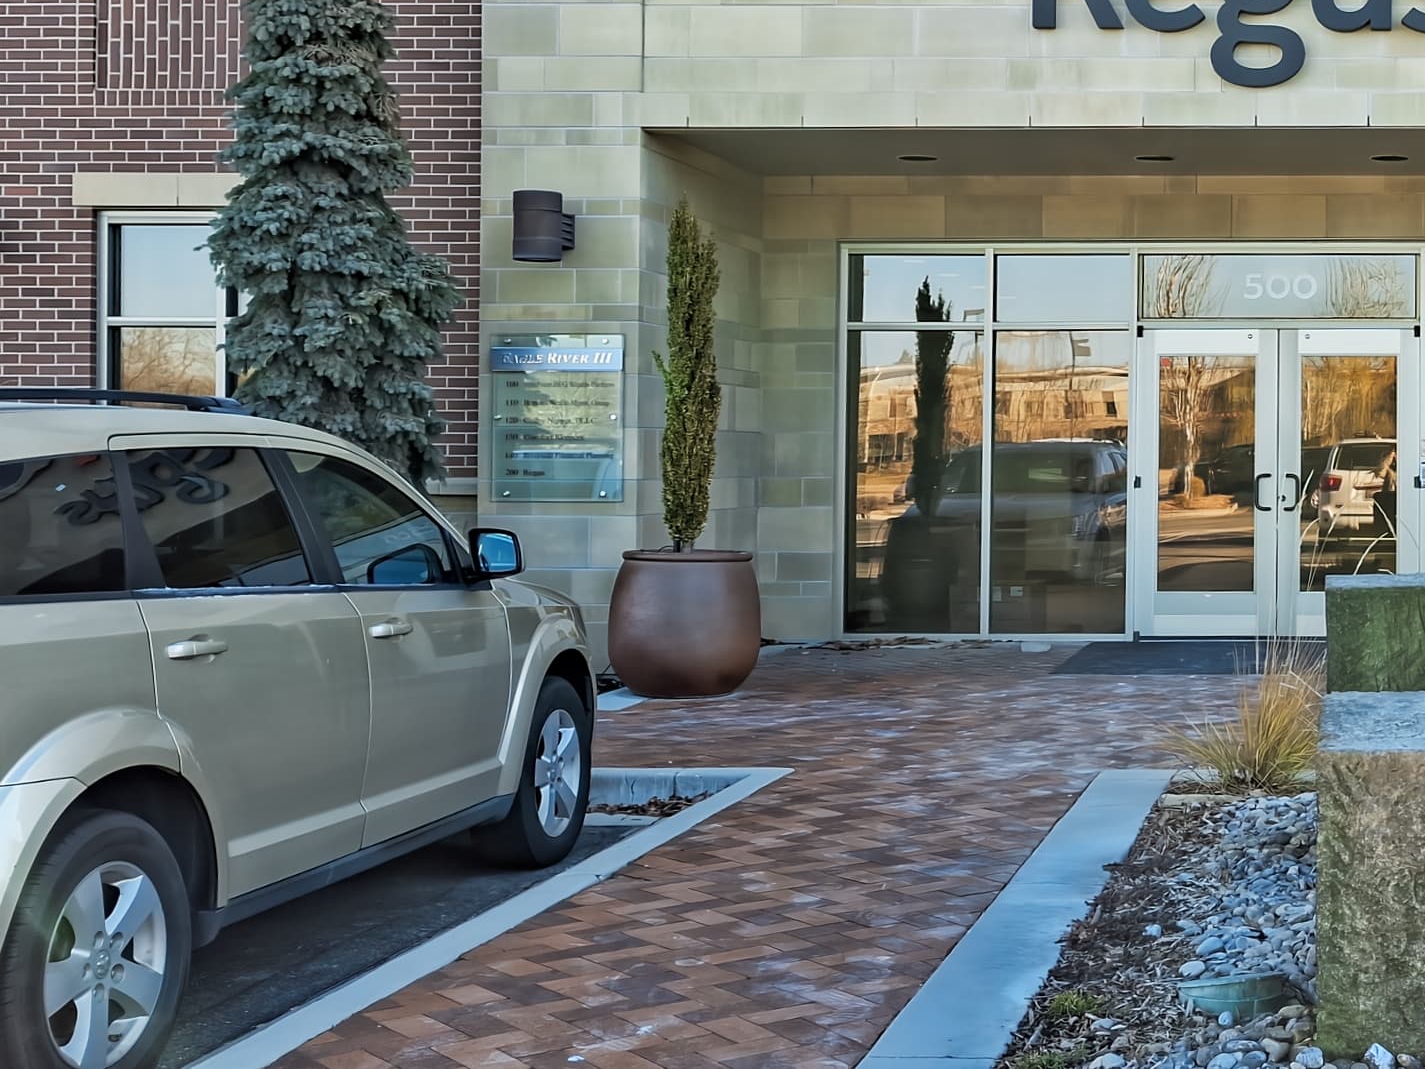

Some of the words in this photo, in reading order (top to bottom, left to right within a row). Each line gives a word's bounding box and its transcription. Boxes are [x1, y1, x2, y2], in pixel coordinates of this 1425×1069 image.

[1242, 272, 1318, 301] 500
[547, 352, 590, 364] RIVER
[593, 352, 613, 364] III
